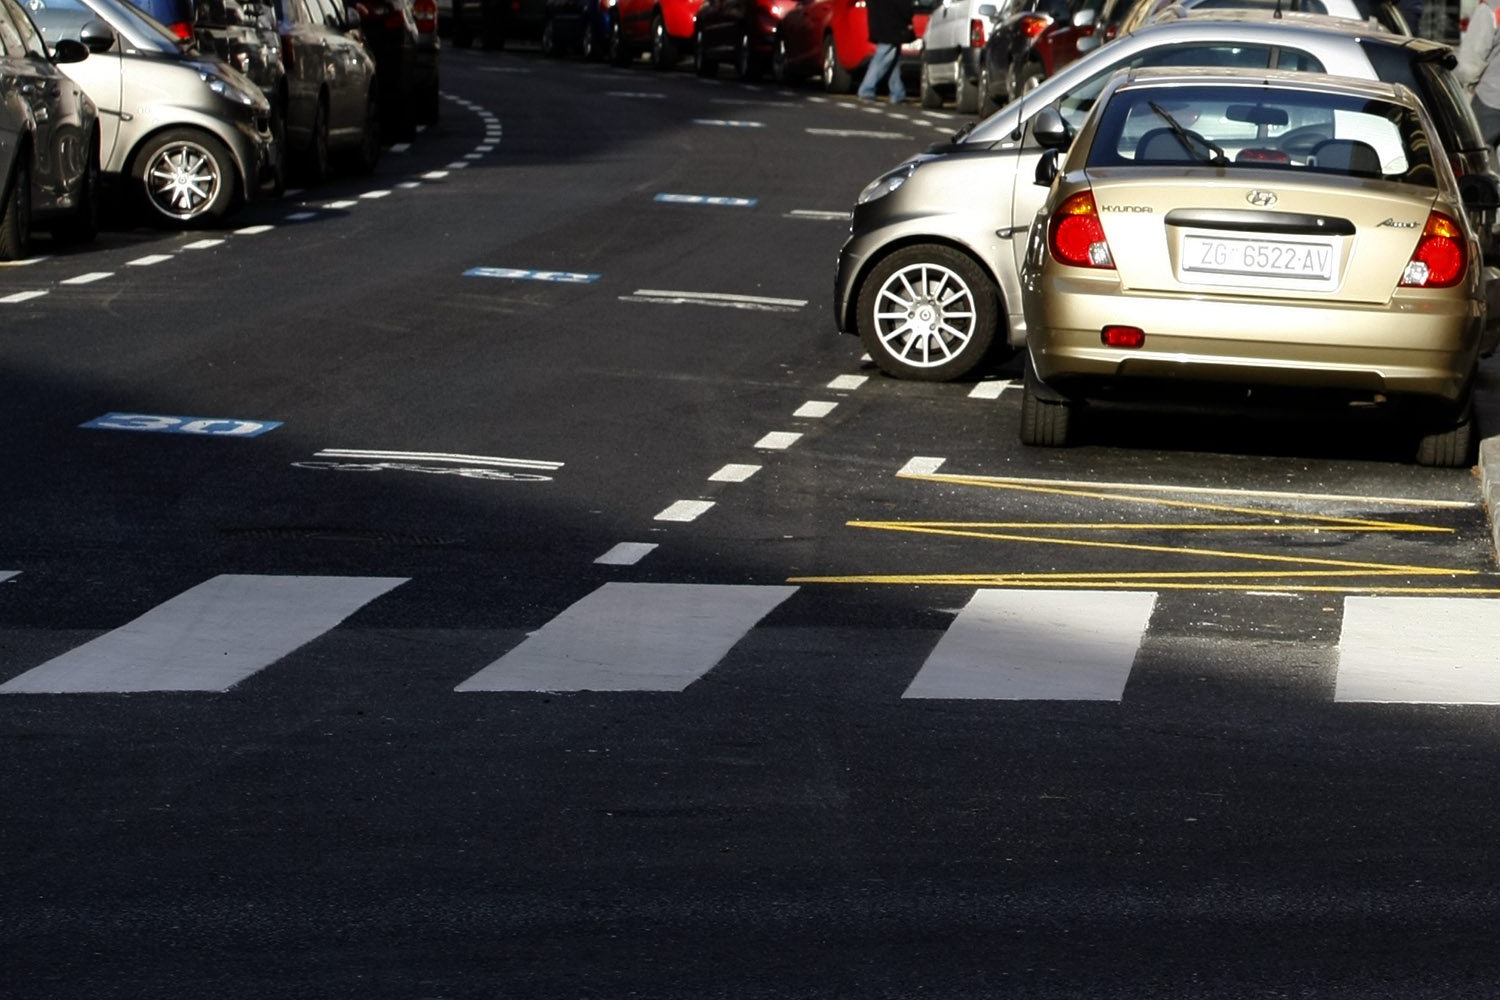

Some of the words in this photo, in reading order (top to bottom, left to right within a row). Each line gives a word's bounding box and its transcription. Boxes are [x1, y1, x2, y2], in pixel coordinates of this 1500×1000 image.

[1102, 205, 1153, 213] HYUNDAI
[1201, 242, 1228, 265] ZG
[98, 415, 264, 435] 30
